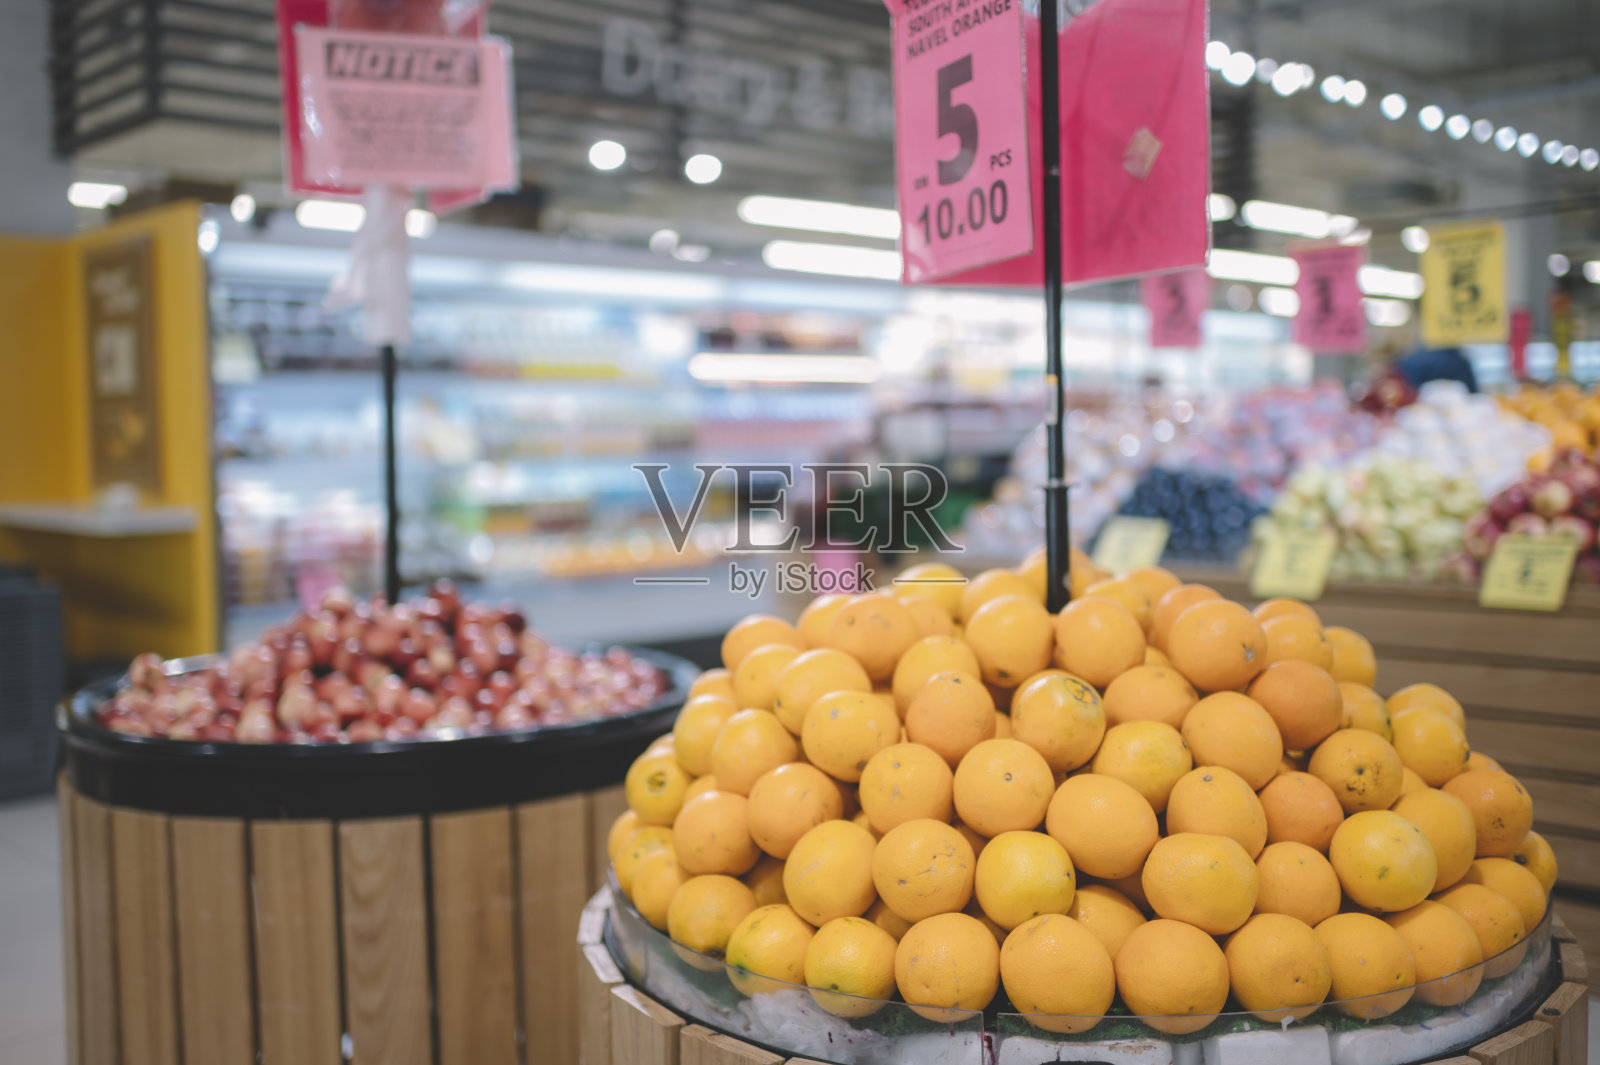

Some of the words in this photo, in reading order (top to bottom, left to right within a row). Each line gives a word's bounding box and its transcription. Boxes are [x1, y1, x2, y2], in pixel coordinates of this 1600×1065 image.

[906, 28, 949, 60] NAVEL
[952, 0, 1012, 36] ORANGE
[331, 46, 473, 82] NOTICE
[937, 54, 978, 186] 5
[990, 148, 1012, 170] PCS
[917, 179, 1008, 245] 10.00
